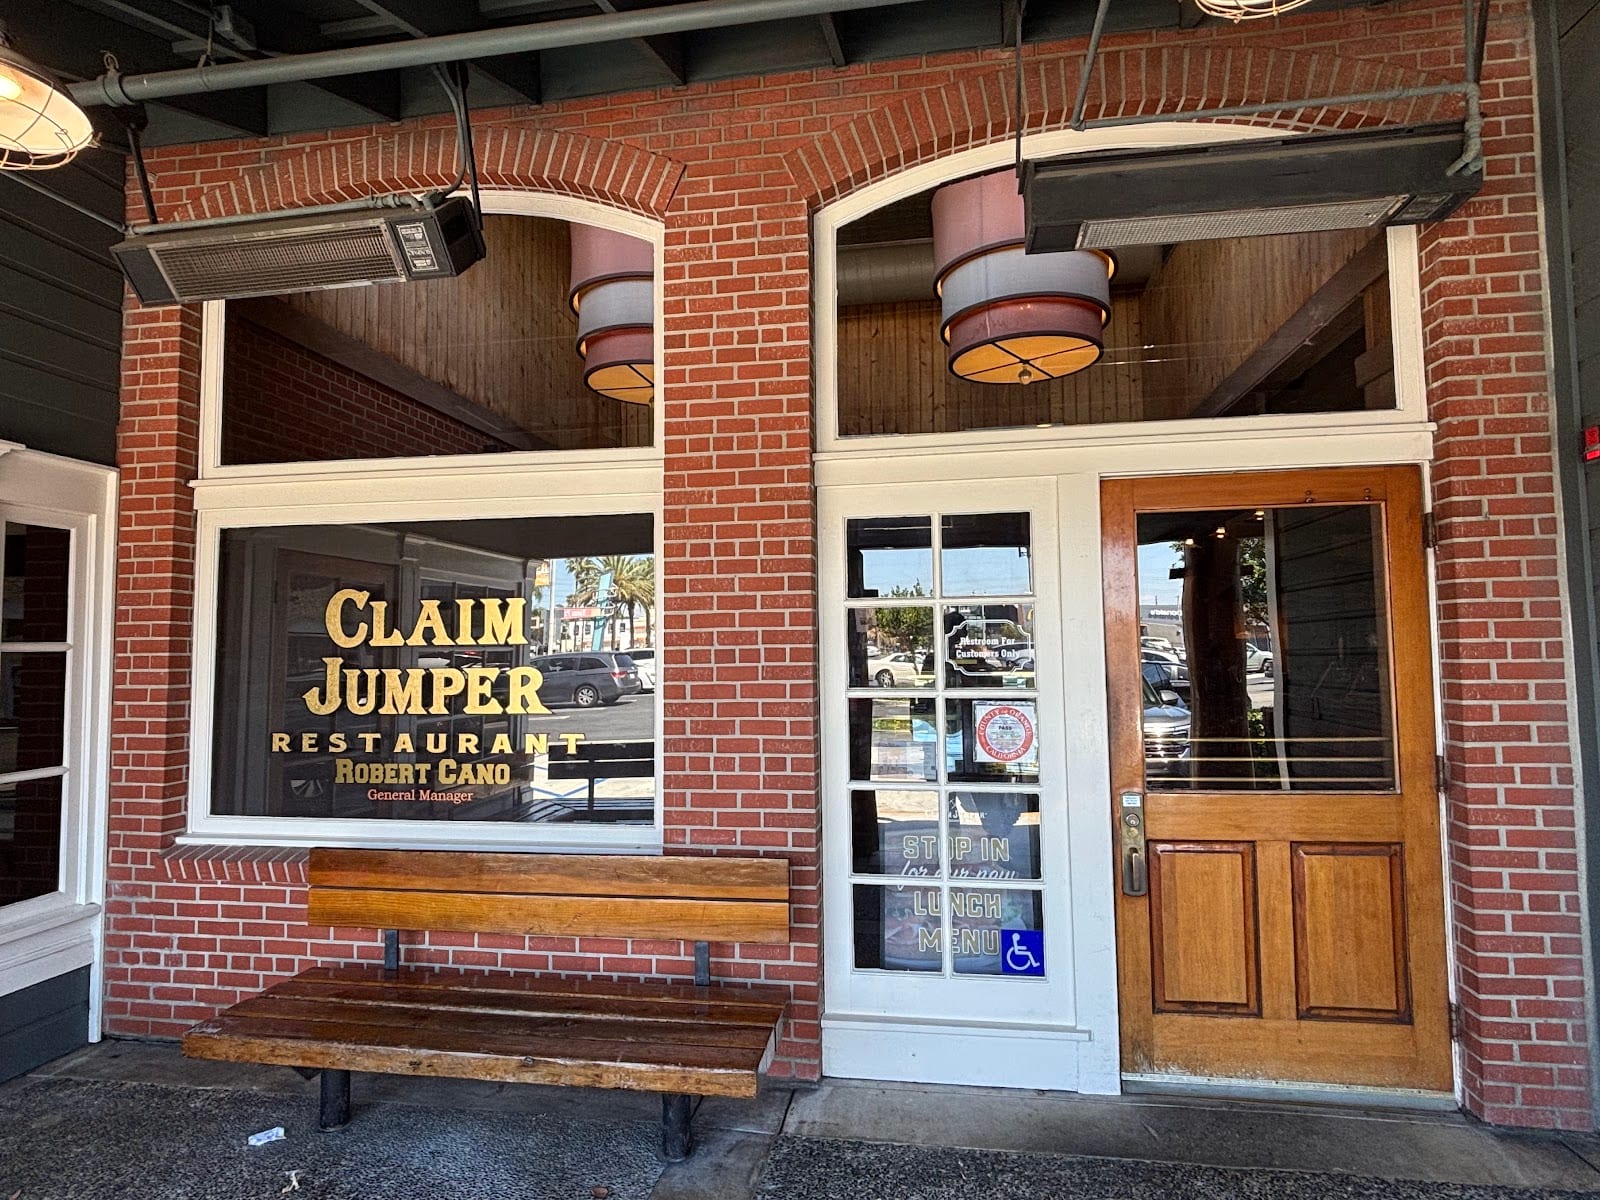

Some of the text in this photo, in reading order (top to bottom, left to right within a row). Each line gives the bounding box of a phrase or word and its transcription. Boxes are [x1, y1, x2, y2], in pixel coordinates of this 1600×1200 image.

[325, 588, 528, 648] CLAIM
[956, 650, 1019, 659] Customers Only
[960, 637, 1015, 646] Restroom For
[302, 657, 552, 715] JUMPER
[979, 709, 1000, 736] COUNTY
[1009, 709, 1032, 737] ORANGE
[272, 733, 585, 754] RESTAURANT
[985, 745, 1027, 760] CALIFORNIA
[335, 758, 510, 784] ROBERT CANO
[367, 789, 474, 804] General Manager
[981, 837, 1009, 861] IN
[897, 860, 928, 891] for
[914, 891, 1001, 918] LUNCH
[919, 928, 999, 955] MENU
